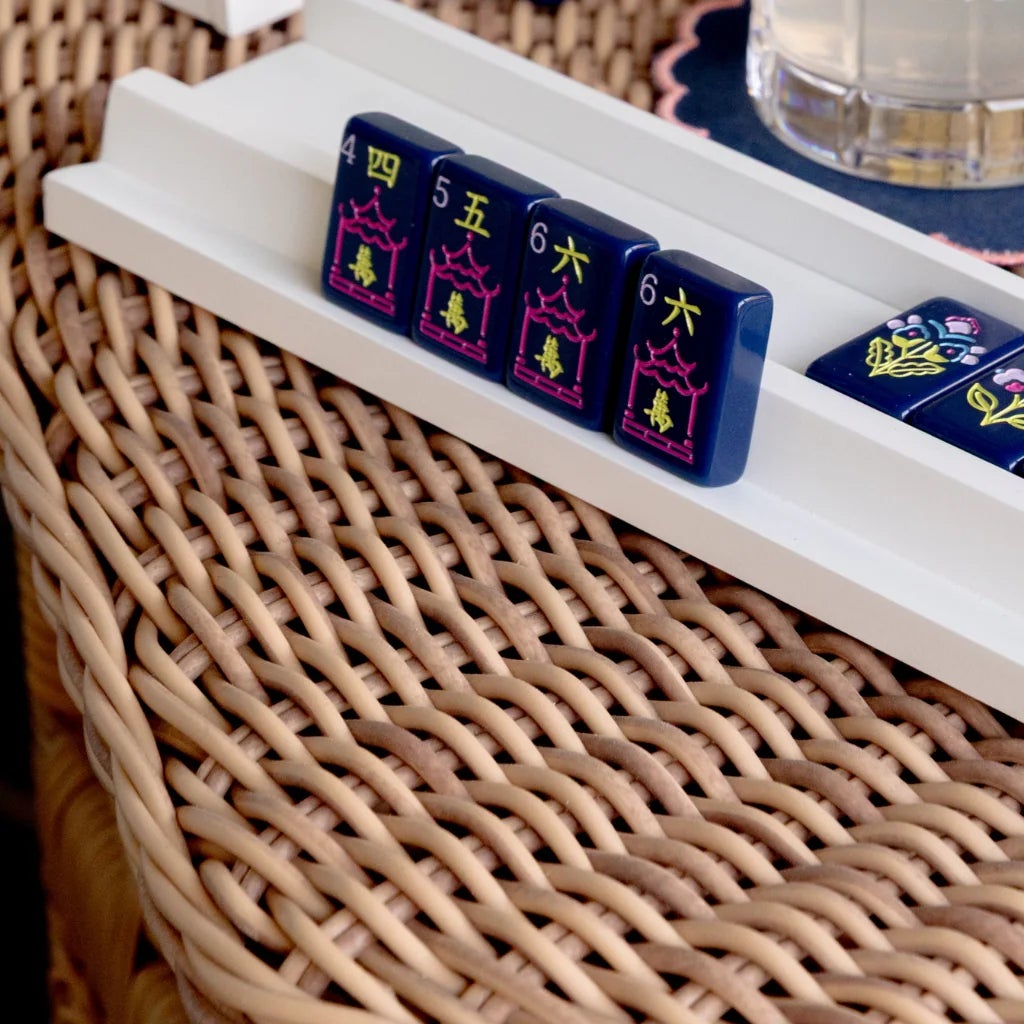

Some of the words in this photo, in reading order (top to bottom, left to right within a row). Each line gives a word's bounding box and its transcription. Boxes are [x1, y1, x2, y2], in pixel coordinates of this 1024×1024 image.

[341, 134, 356, 165] 4
[367, 145, 401, 189] 四
[433, 175, 451, 208] 5
[454, 190, 491, 238] 五
[530, 222, 549, 254] 6
[552, 236, 590, 284] 六
[639, 273, 659, 306] 6
[661, 287, 702, 336] 六
